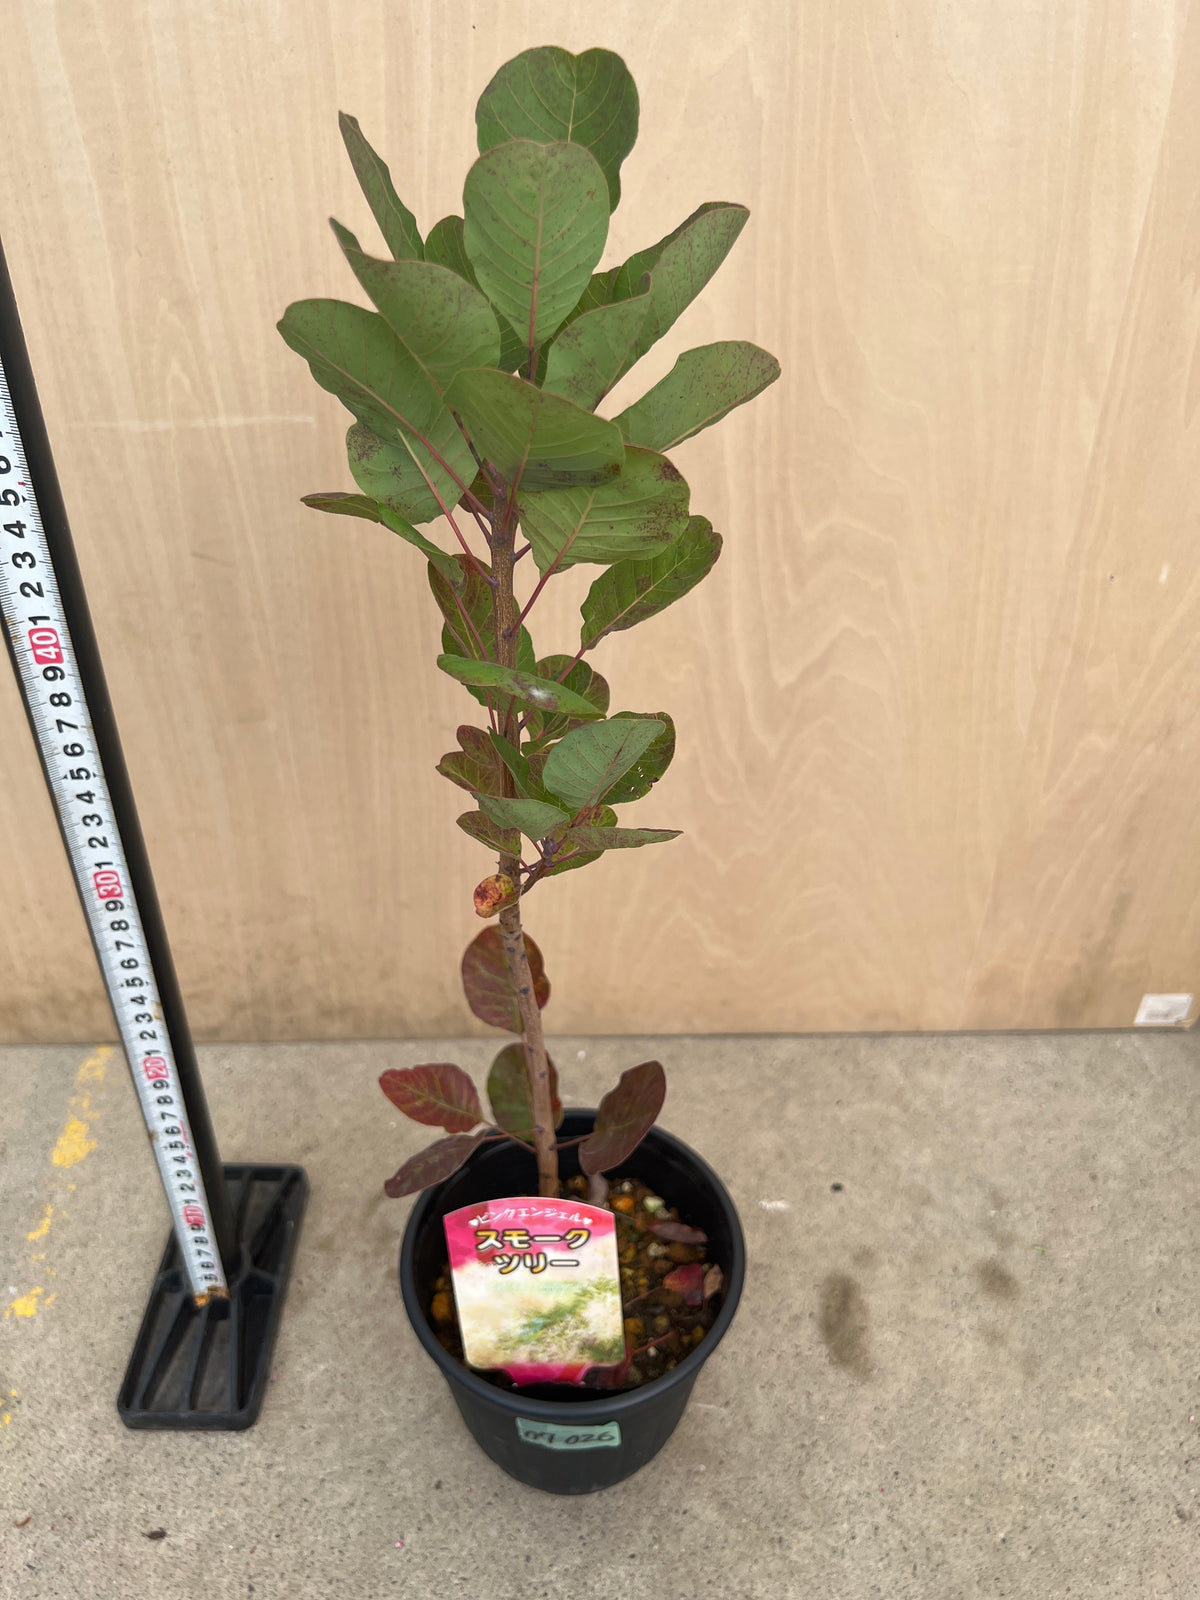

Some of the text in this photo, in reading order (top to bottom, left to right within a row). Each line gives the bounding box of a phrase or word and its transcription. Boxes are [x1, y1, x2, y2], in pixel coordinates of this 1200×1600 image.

[0, 489, 20, 506] 5
[3, 520, 26, 538] 4
[12, 552, 36, 569] 3
[20, 582, 44, 598] 2
[28, 616, 50, 626] 1
[31, 630, 60, 660] 40
[42, 666, 65, 681] 9
[50, 692, 72, 707] 8
[56, 719, 78, 733] 7
[63, 743, 84, 756] 6
[69, 768, 91, 780] 5
[76, 790, 96, 804] 4
[82, 814, 102, 826] 3
[88, 836, 108, 848] 2
[96, 872, 122, 897] 30
[105, 900, 124, 911] 9
[110, 920, 130, 931] 8
[115, 940, 134, 951] 7
[120, 958, 138, 969] 6
[126, 976, 144, 987] 5
[130, 994, 148, 1005] 4
[135, 1012, 152, 1022] 3
[140, 1030, 158, 1040] 2
[153, 1080, 169, 1089] 9
[157, 1095, 174, 1104] 8
[161, 1112, 177, 1120] 7
[176, 1170, 192, 1178] 3
[180, 1183, 196, 1192] 2
[474, 1228, 591, 1251] スモーク
[196, 1249, 212, 1257] 7
[493, 1253, 579, 1275] ツリー
[565, 1431, 615, 1445] 026
